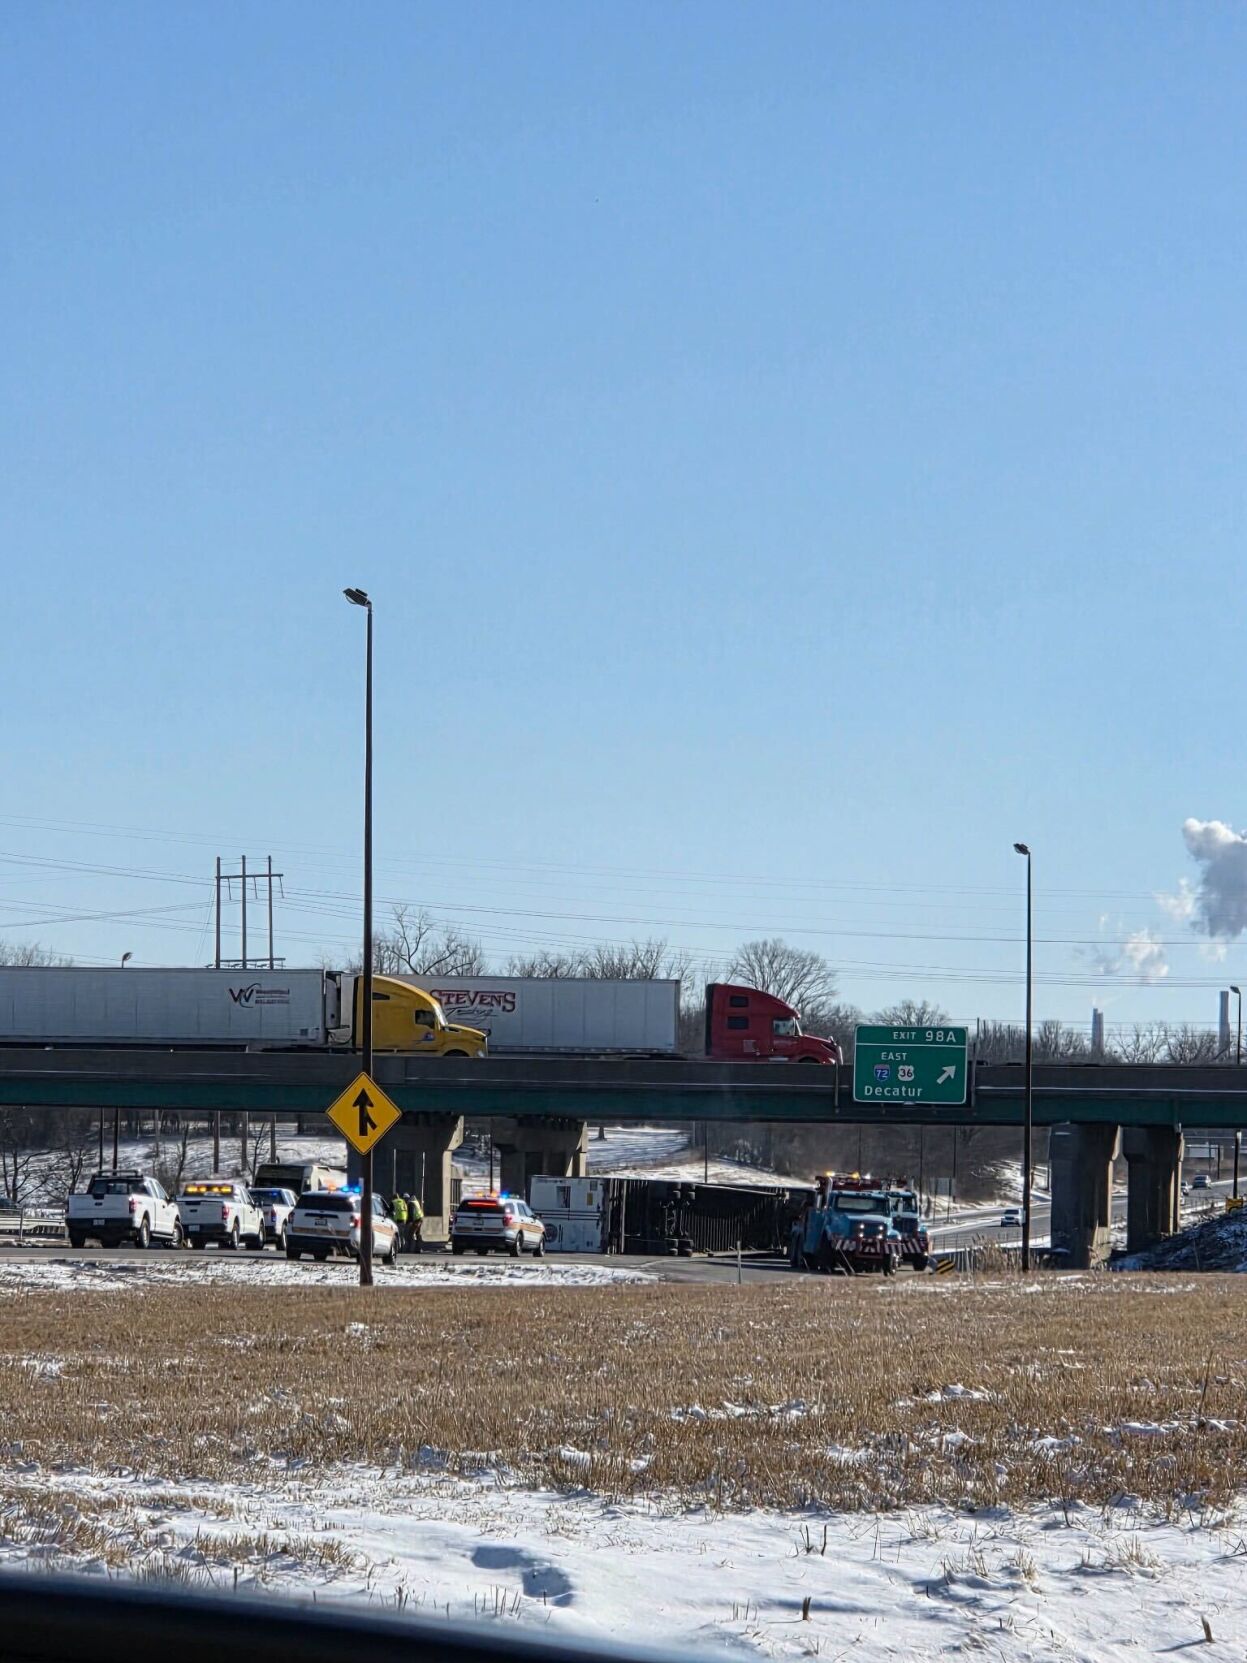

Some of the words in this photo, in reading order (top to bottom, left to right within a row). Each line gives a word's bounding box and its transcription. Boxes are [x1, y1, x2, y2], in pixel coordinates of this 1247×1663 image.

[430, 989, 516, 1013] STEVENS
[893, 1031, 916, 1040] EXIT
[925, 1030, 956, 1043] 98A
[881, 1052, 907, 1061] EAST
[876, 1069, 888, 1078] 72
[900, 1069, 912, 1078] 36
[864, 1085, 923, 1097] Decatur
